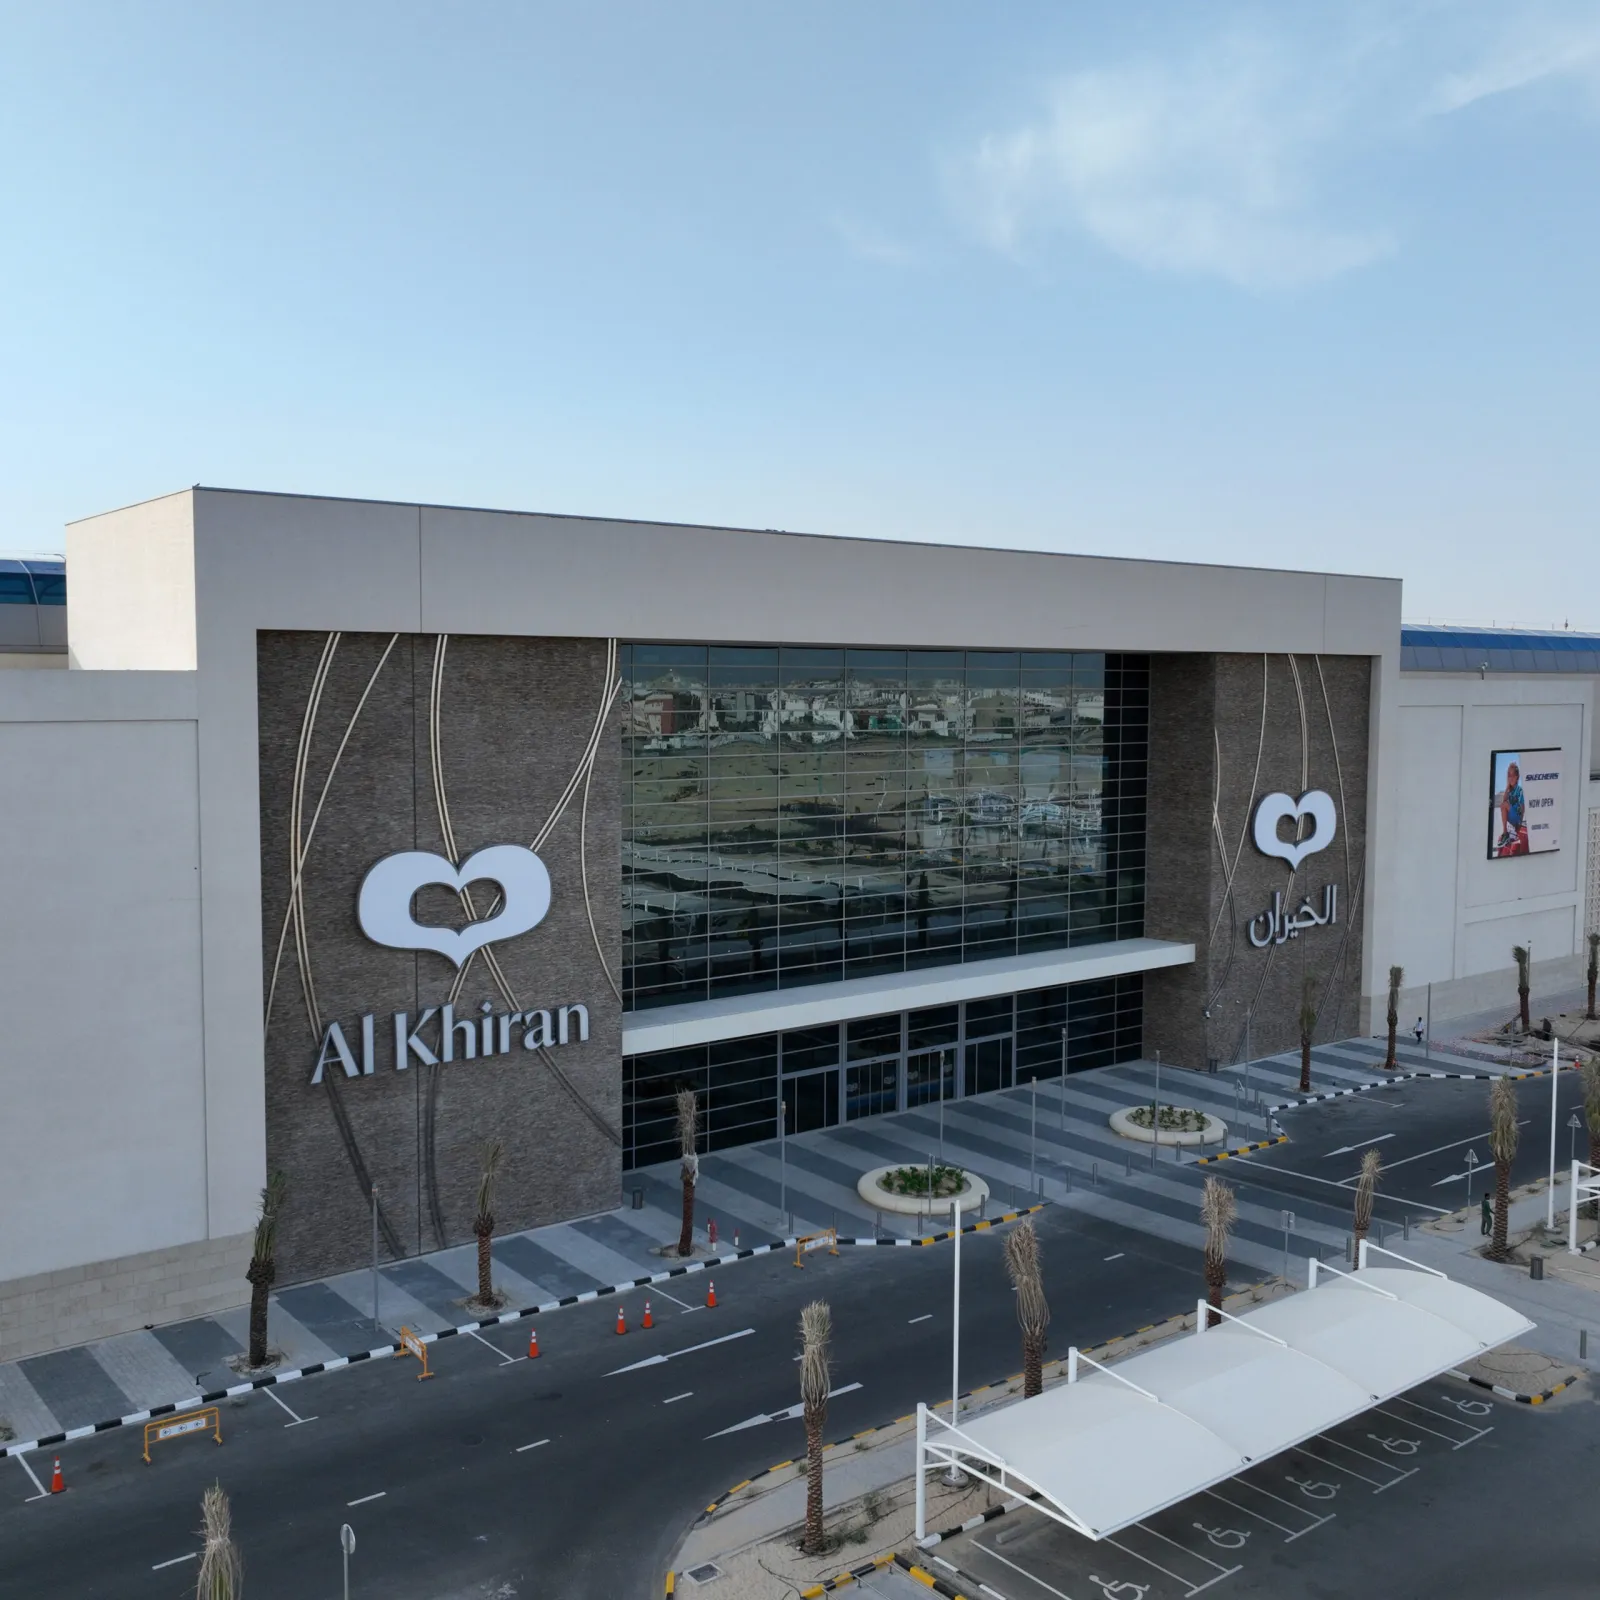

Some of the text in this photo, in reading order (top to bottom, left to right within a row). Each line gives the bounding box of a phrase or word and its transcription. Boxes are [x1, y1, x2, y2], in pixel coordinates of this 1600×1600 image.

[1525, 772, 1560, 782] SKECHERS
[1528, 798, 1554, 808] NOW OPEN
[1248, 884, 1337, 948] الخيران
[310, 1001, 590, 1085] Al Khiran
